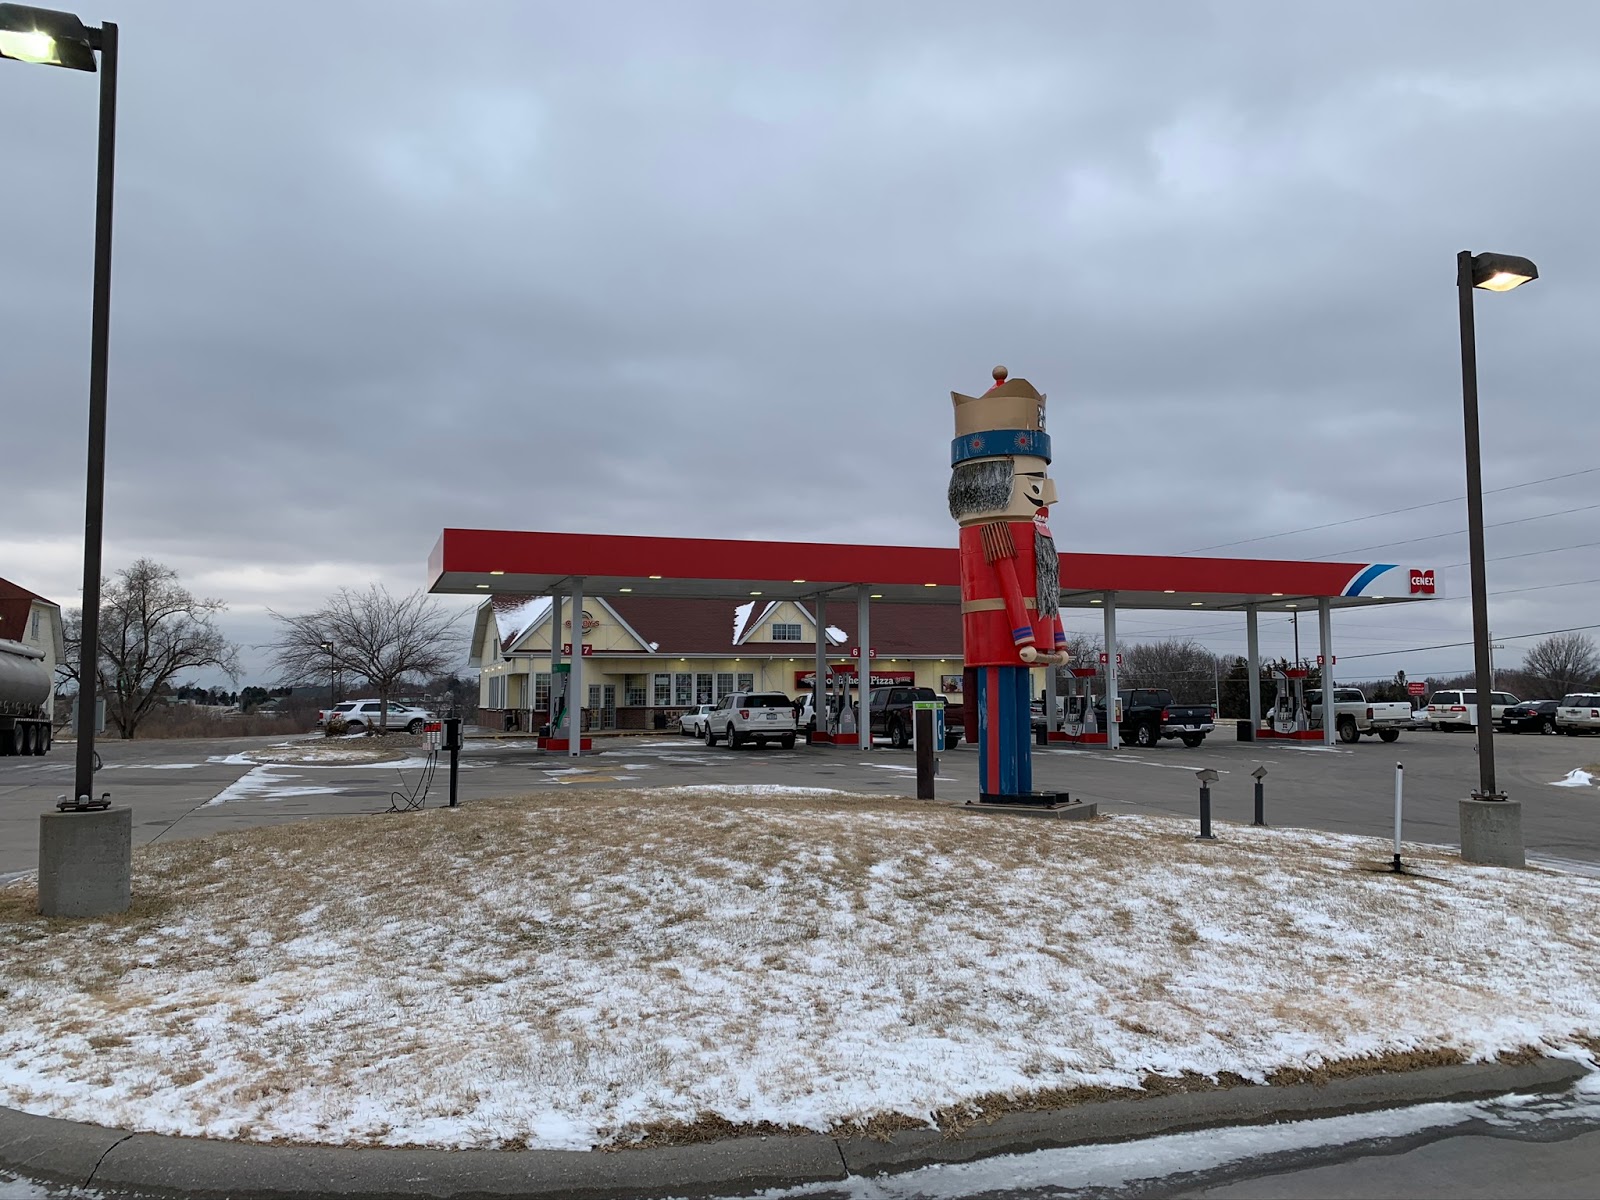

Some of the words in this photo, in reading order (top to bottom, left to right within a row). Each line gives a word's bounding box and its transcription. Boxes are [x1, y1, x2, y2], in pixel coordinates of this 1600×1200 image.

[1411, 577, 1434, 585] CENEX
[565, 645, 570, 653] 8
[583, 646, 589, 654] 7
[853, 648, 858, 656] 6
[869, 649, 874, 657] 5
[870, 676, 894, 684] Pizza
